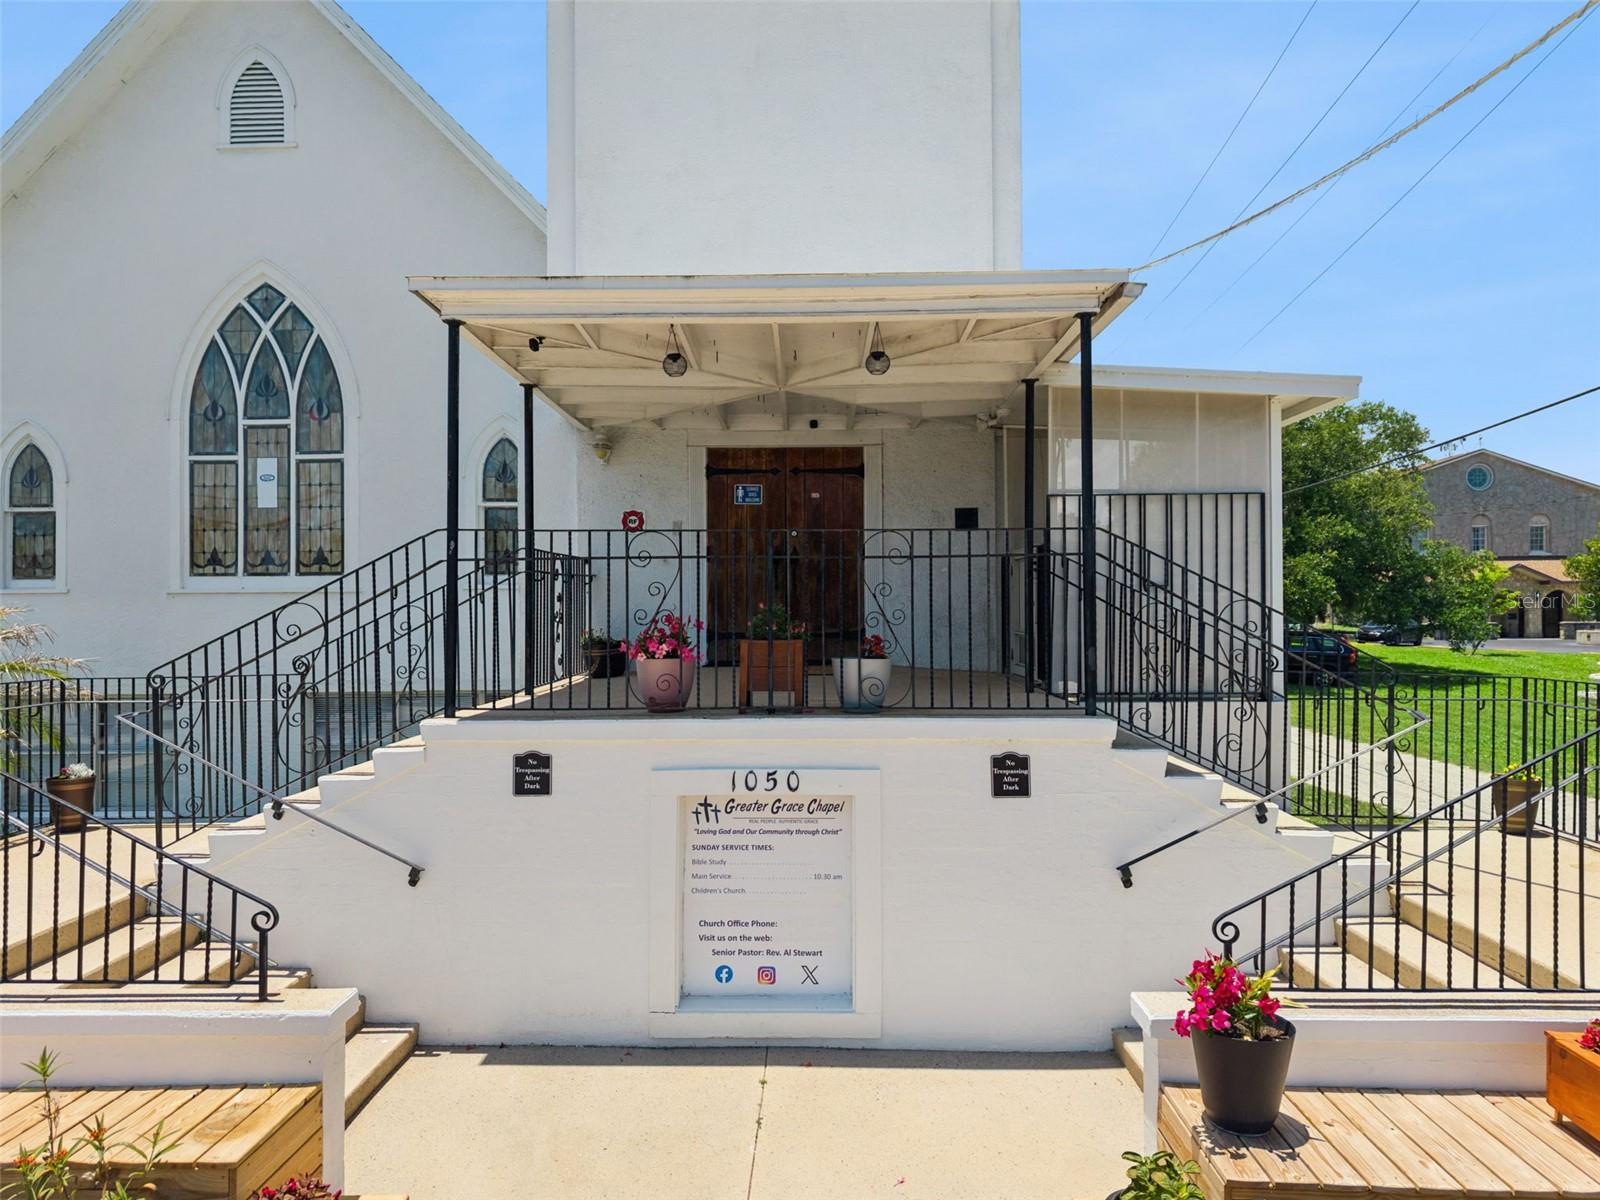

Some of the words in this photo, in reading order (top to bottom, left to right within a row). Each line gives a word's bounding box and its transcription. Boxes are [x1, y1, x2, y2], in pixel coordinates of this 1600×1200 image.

[731, 770, 800, 792] 1050
[724, 798, 769, 814] Greater
[770, 798, 805, 814] Grace
[807, 798, 845, 816] Chapel
[758, 828, 794, 836] Community
[795, 828, 819, 836] through
[708, 859, 727, 867] Study
[698, 919, 726, 928] Church
[726, 919, 750, 928] Office
[751, 919, 778, 928] Phone:
[698, 934, 716, 942] Visit
[739, 934, 753, 942] the
[753, 934, 773, 942] web:
[711, 948, 736, 956] Senior
[737, 948, 765, 957] Pastor:
[765, 948, 782, 957] Rev.
[783, 948, 792, 957] Al
[793, 949, 823, 957] Stewart
